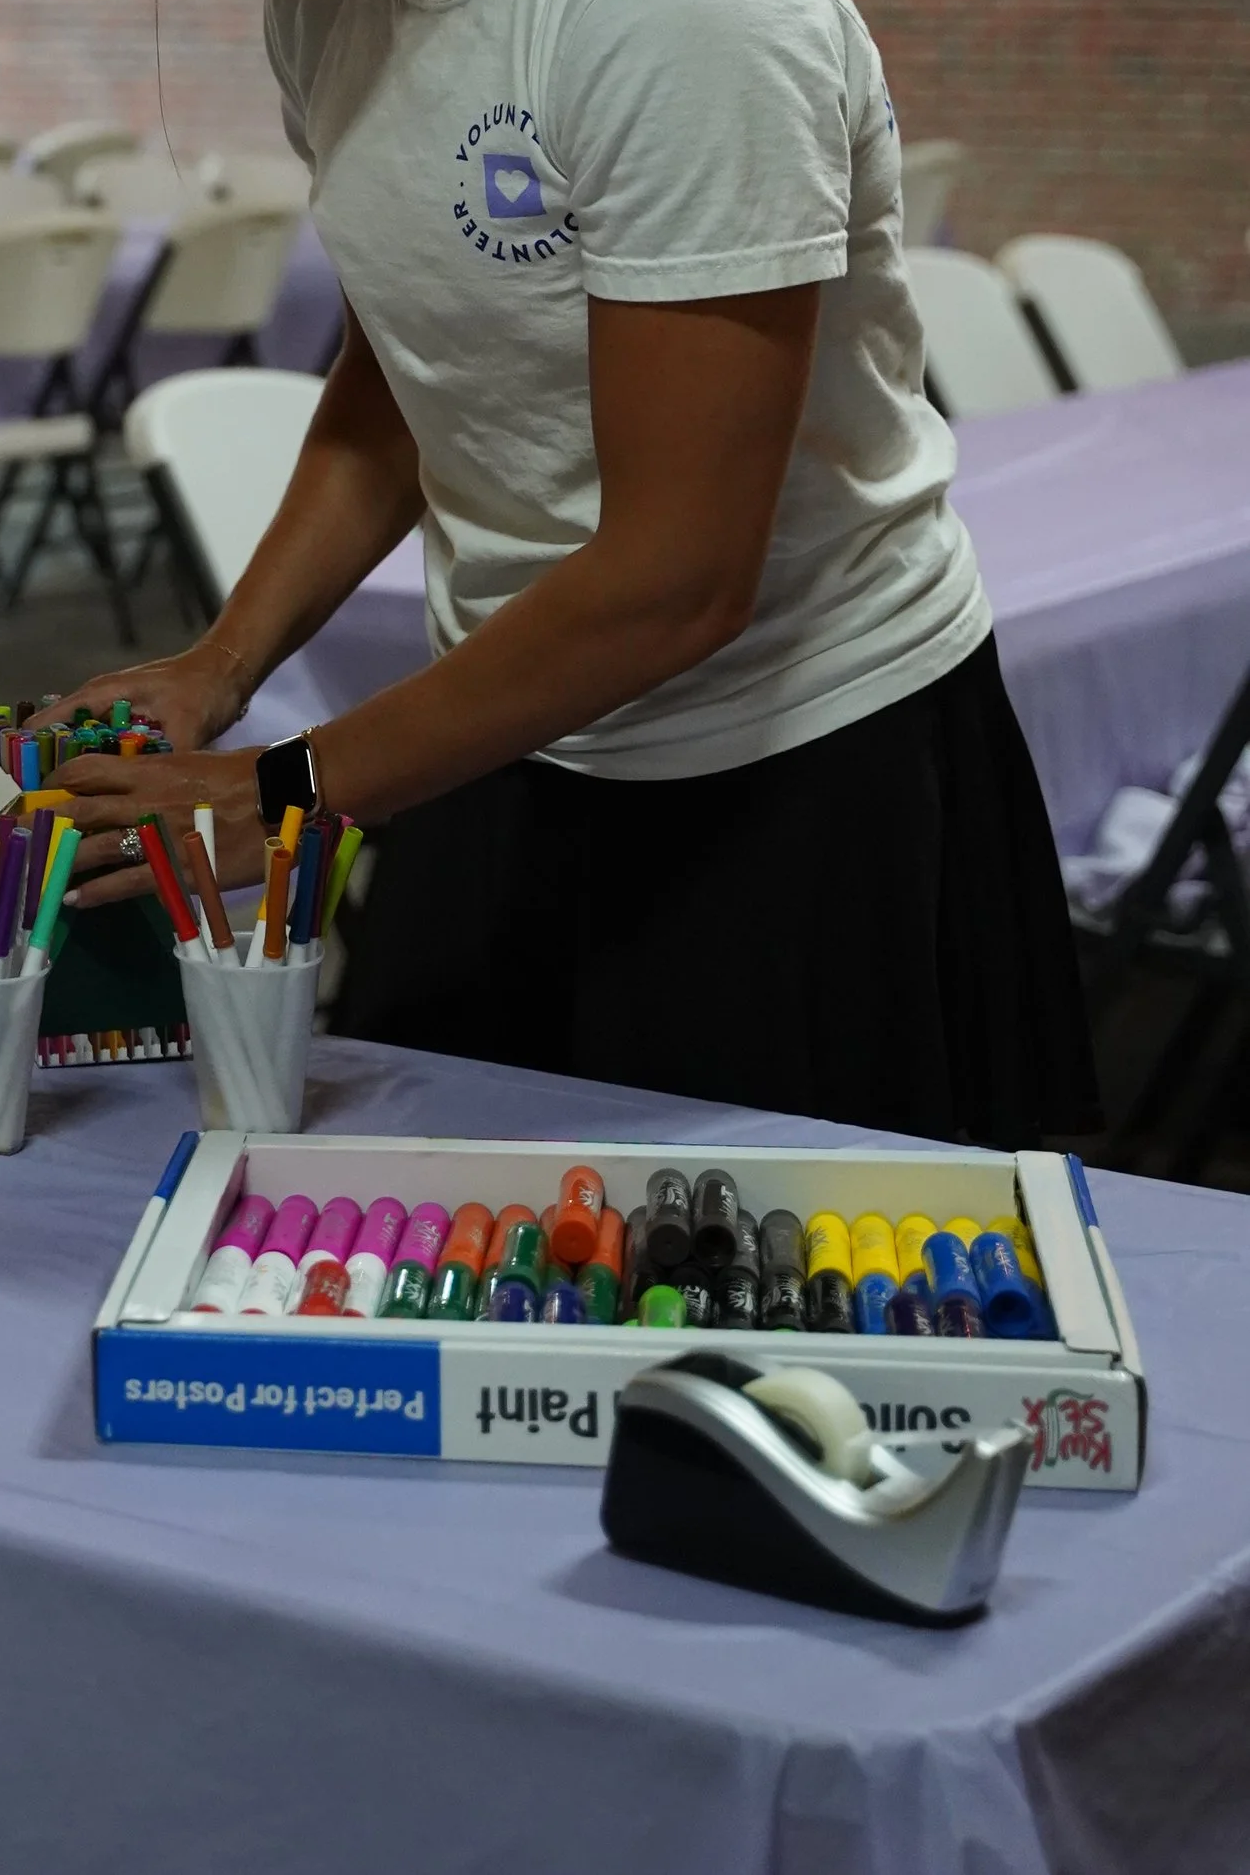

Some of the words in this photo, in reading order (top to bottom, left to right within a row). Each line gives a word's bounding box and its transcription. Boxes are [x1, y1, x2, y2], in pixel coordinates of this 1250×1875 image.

[456, 102, 541, 163] VOLUNT
[453, 200, 580, 263] OLUNTEER
[124, 1378, 246, 1413] Posters
[250, 1383, 298, 1413] for
[302, 1384, 426, 1420] Perfect
[475, 1386, 599, 1439] Paint
